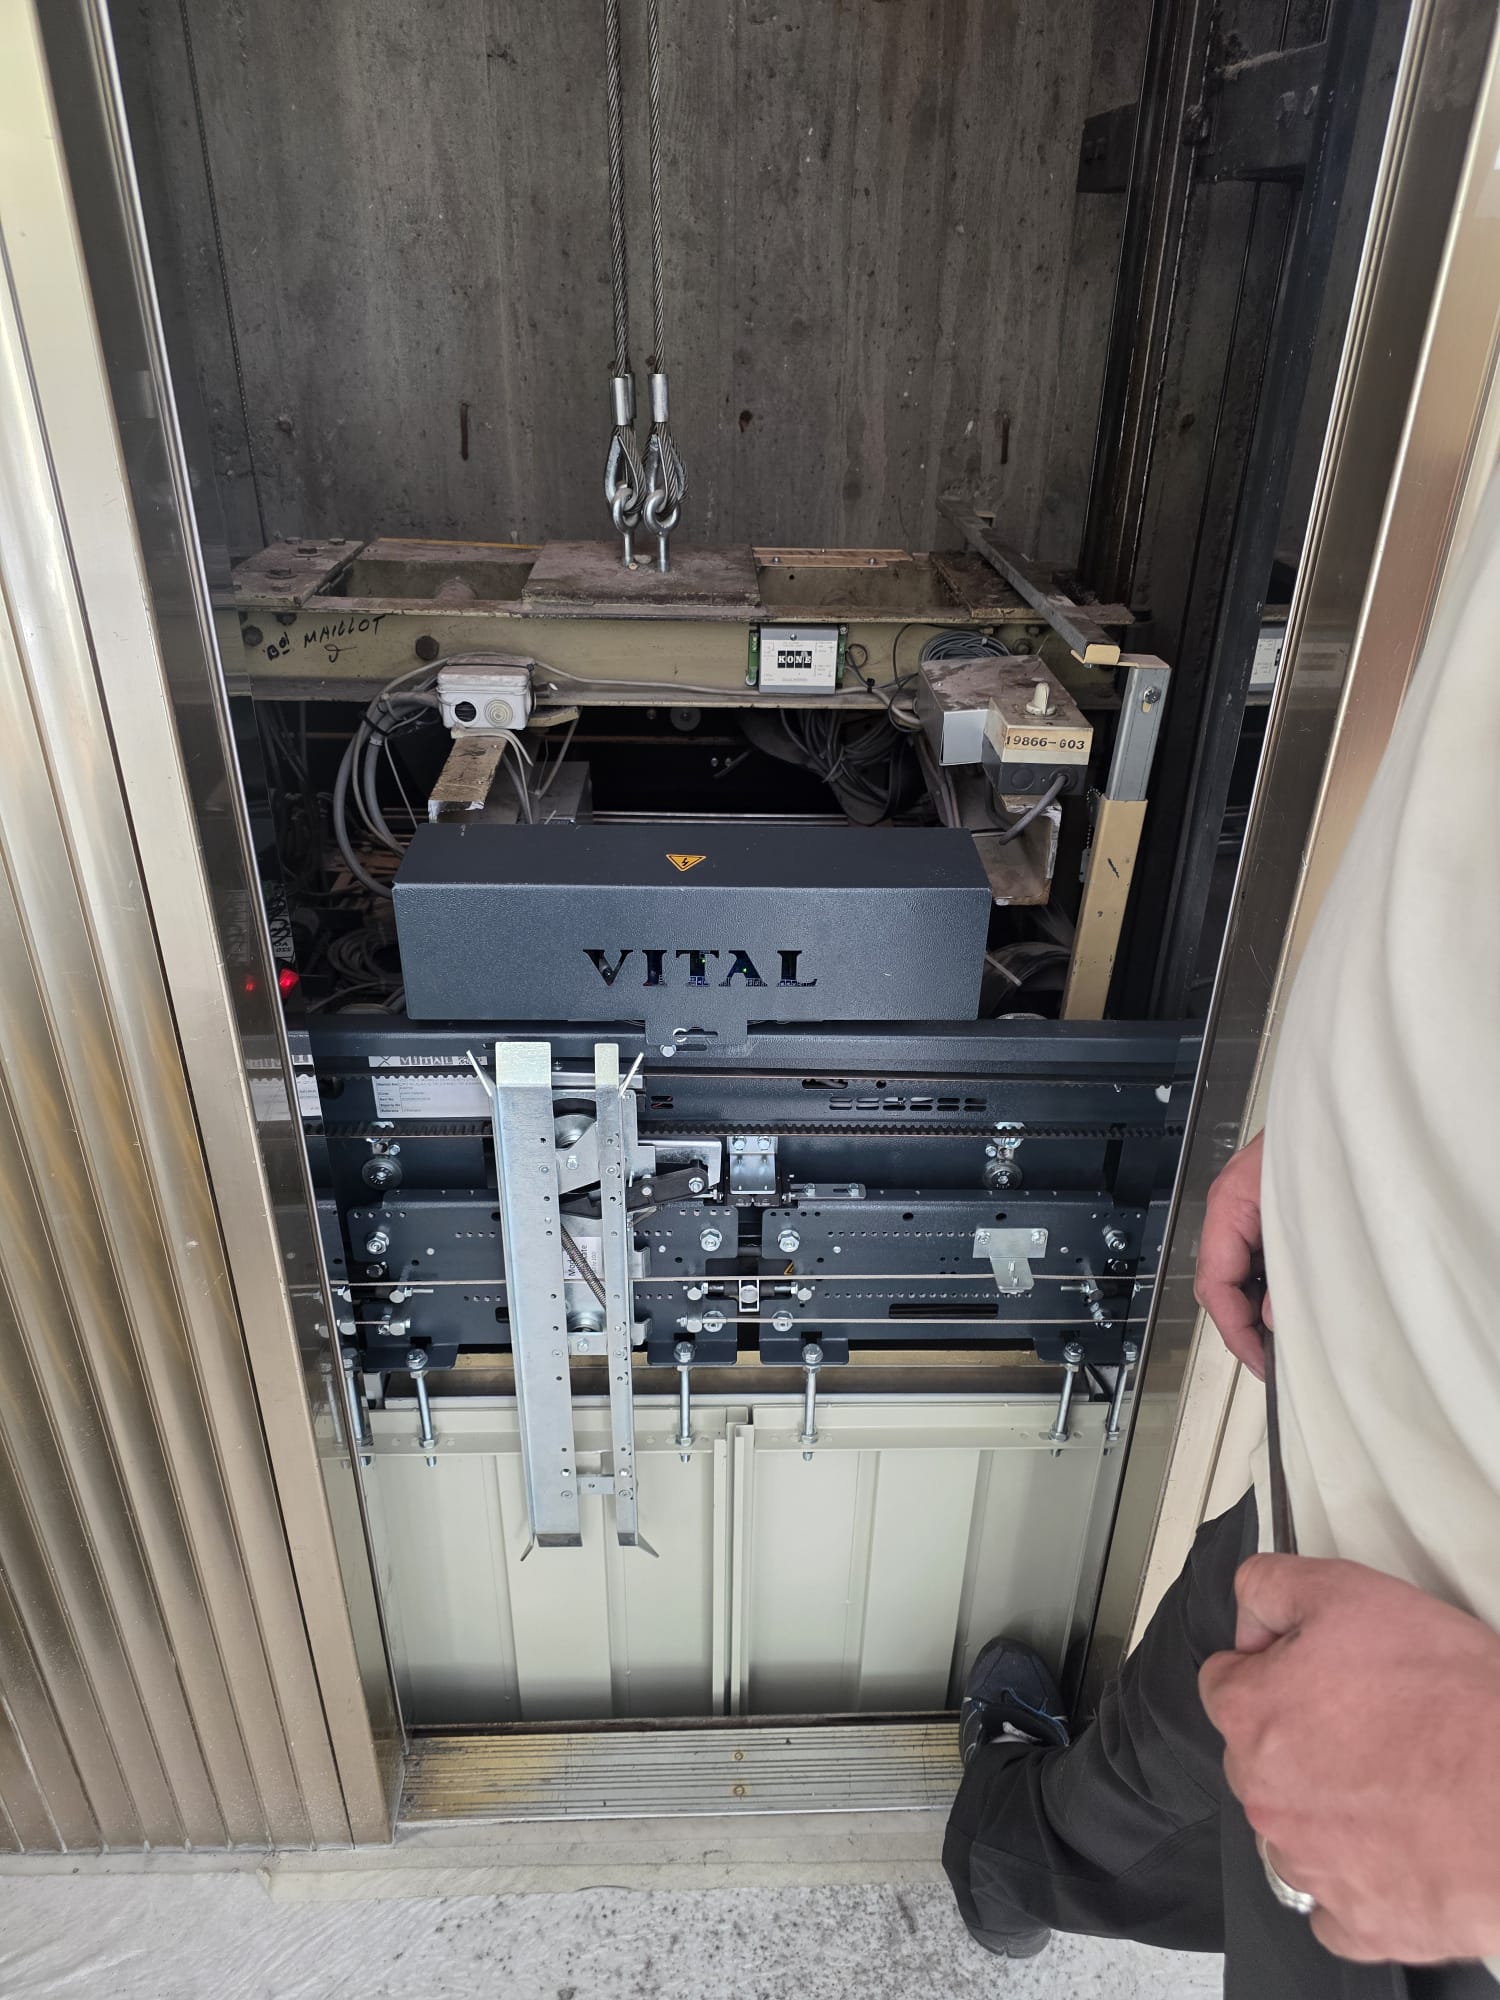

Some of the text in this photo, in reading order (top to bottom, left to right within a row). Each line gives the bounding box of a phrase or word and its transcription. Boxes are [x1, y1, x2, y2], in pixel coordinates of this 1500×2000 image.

[303, 613, 386, 648] MAILLOT
[777, 652, 812, 667] KONE
[582, 948, 818, 987] VITAL
